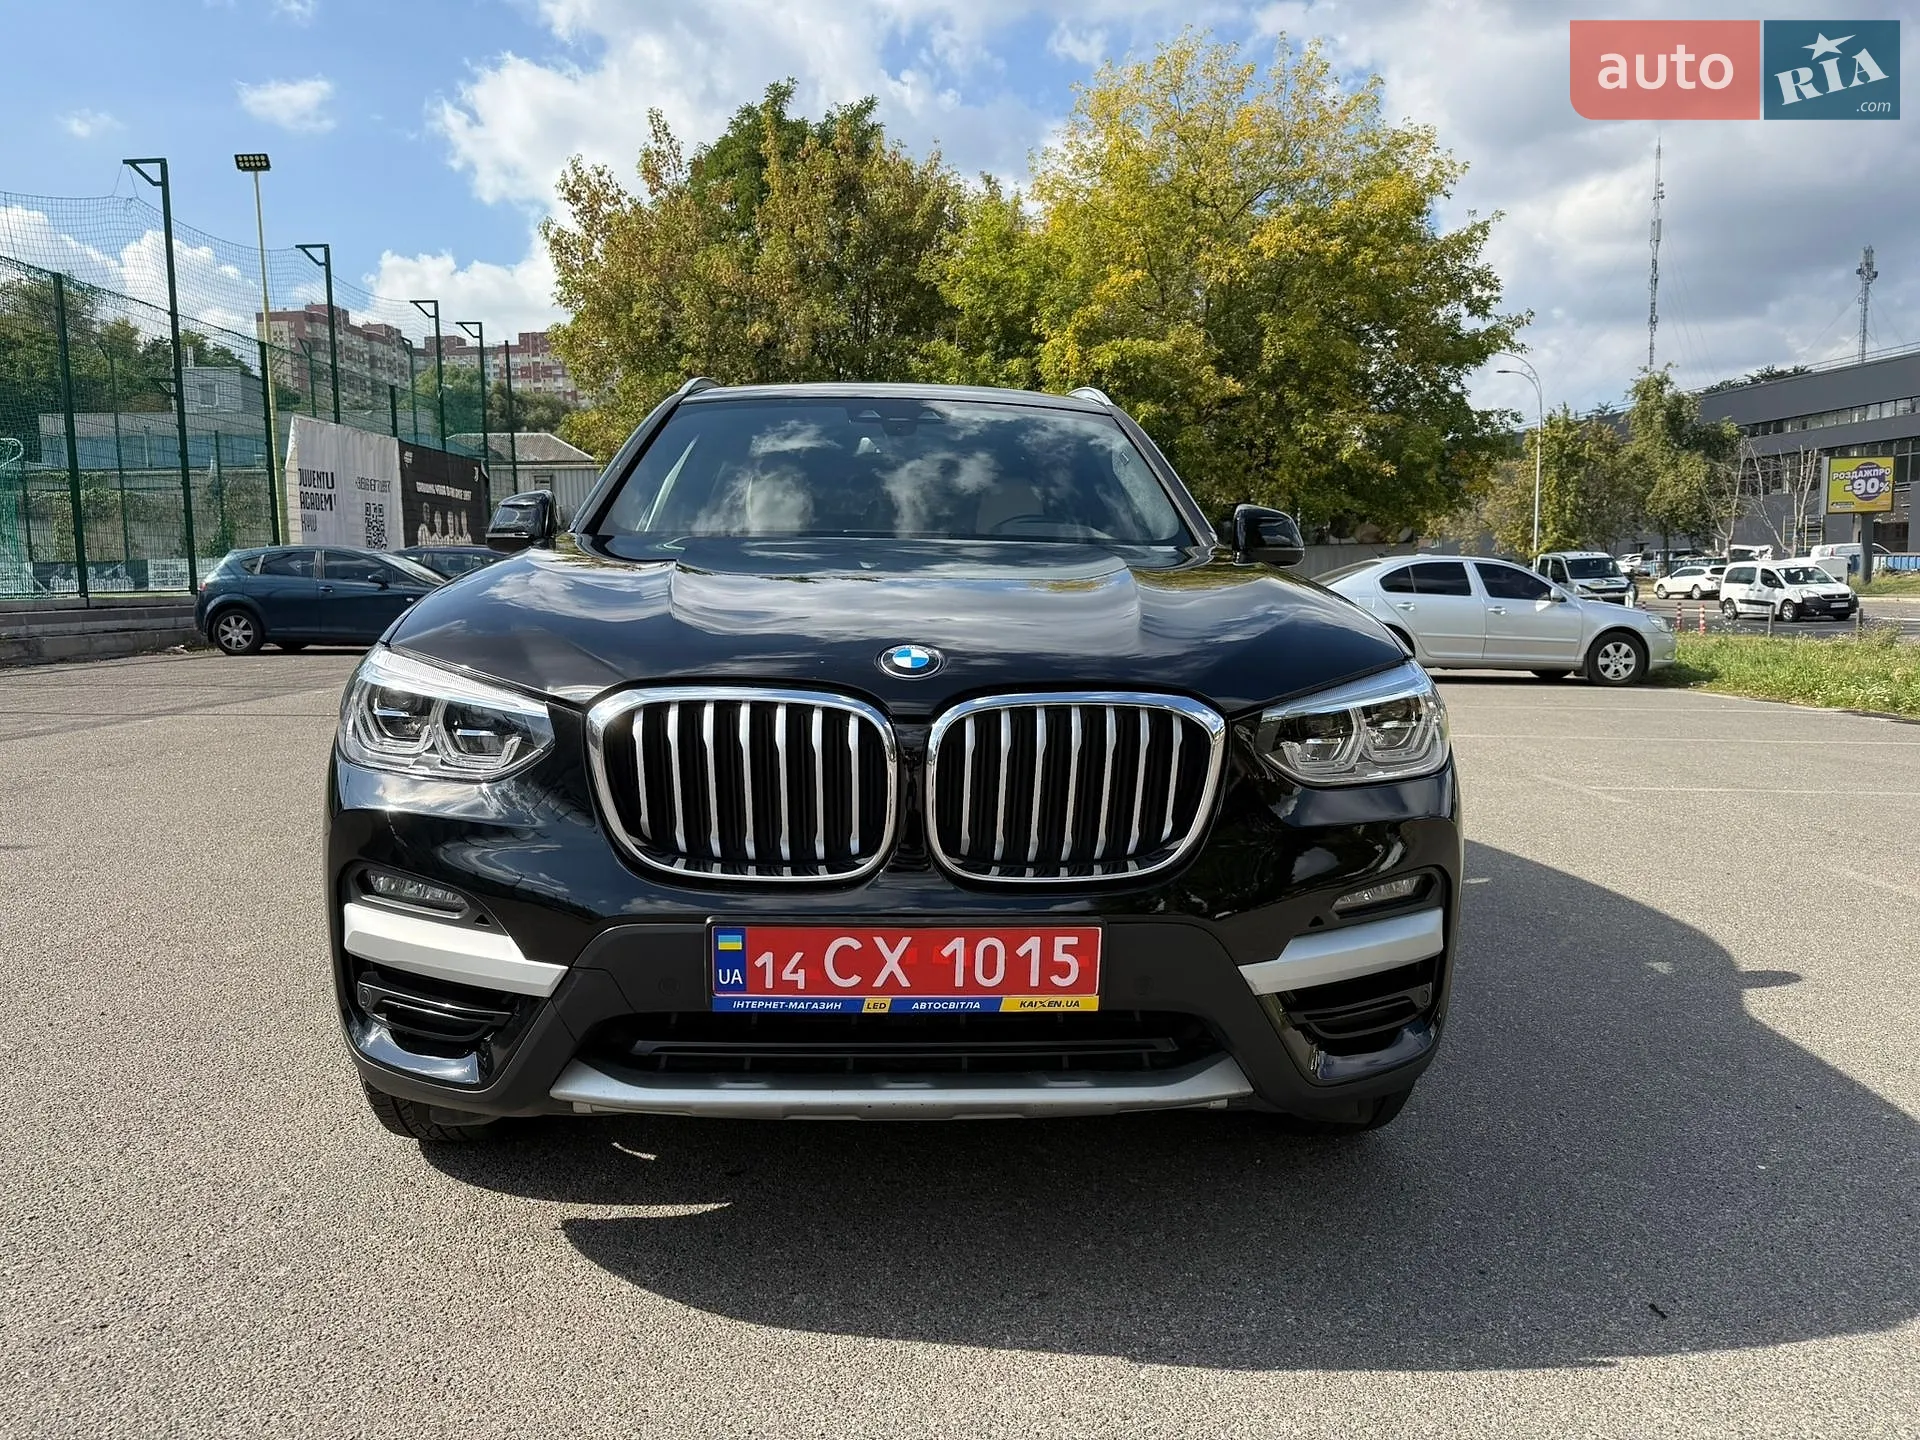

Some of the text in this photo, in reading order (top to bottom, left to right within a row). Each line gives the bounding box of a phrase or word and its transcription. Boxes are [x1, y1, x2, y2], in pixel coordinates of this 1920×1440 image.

[298, 468, 335, 489] JUVENTU
[1844, 477, 1890, 495] -90%
[754, 936, 1080, 989] 14 CX 1015
[718, 968, 743, 985] UA
[732, 1000, 842, 1010] ІНТЕРНЕТ-МАГАЗИН
[866, 1001, 887, 1010] LED
[911, 1001, 981, 1010] АВТОСВІТЛА
